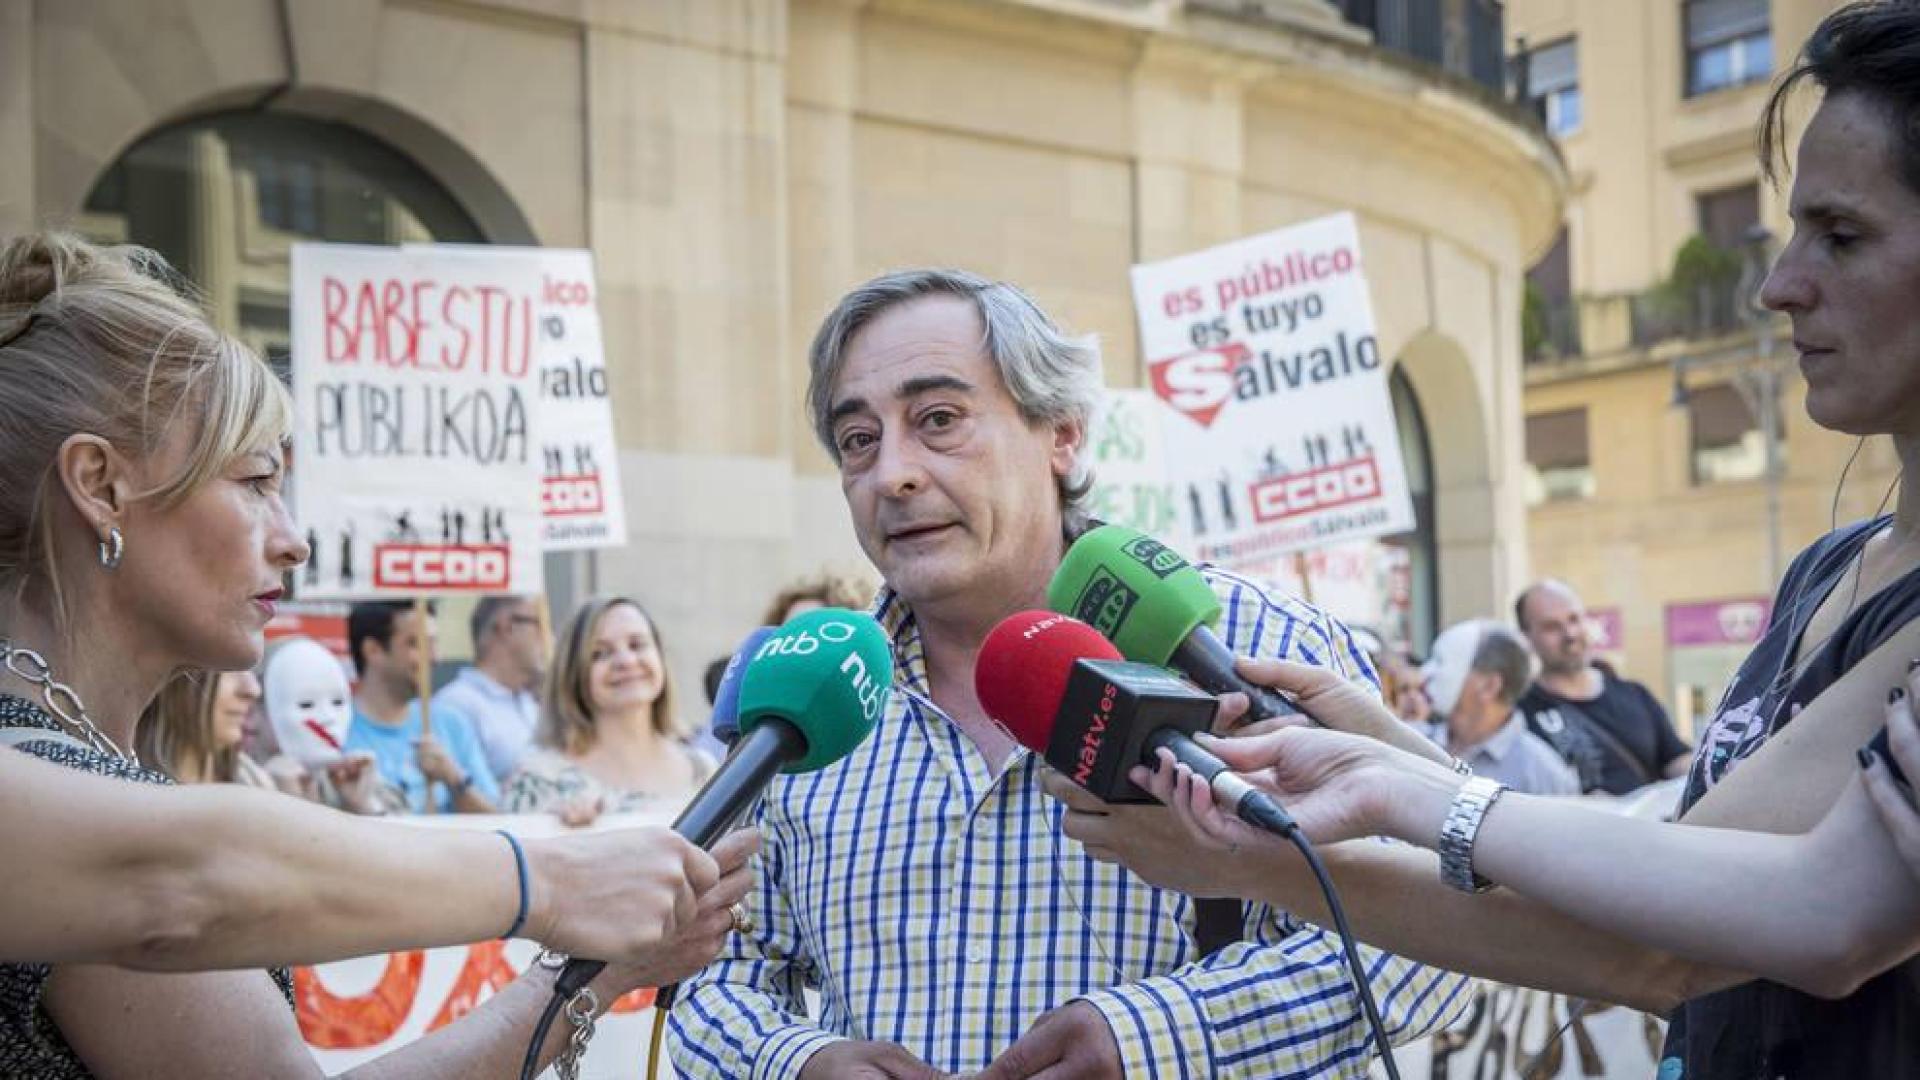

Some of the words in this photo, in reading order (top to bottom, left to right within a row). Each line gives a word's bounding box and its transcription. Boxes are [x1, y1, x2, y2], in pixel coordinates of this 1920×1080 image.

[323, 276, 531, 378] BABESTU
[1163, 292, 1204, 318] es
[1191, 314, 1231, 348] es
[1242, 292, 1325, 333] tuyo
[1162, 332, 1381, 412] Sálvalo
[316, 383, 527, 466] PUBLIKOA
[1254, 462, 1379, 519] CCOO
[378, 550, 507, 585] CCOO
[1073, 683, 1118, 786] Natv.es
